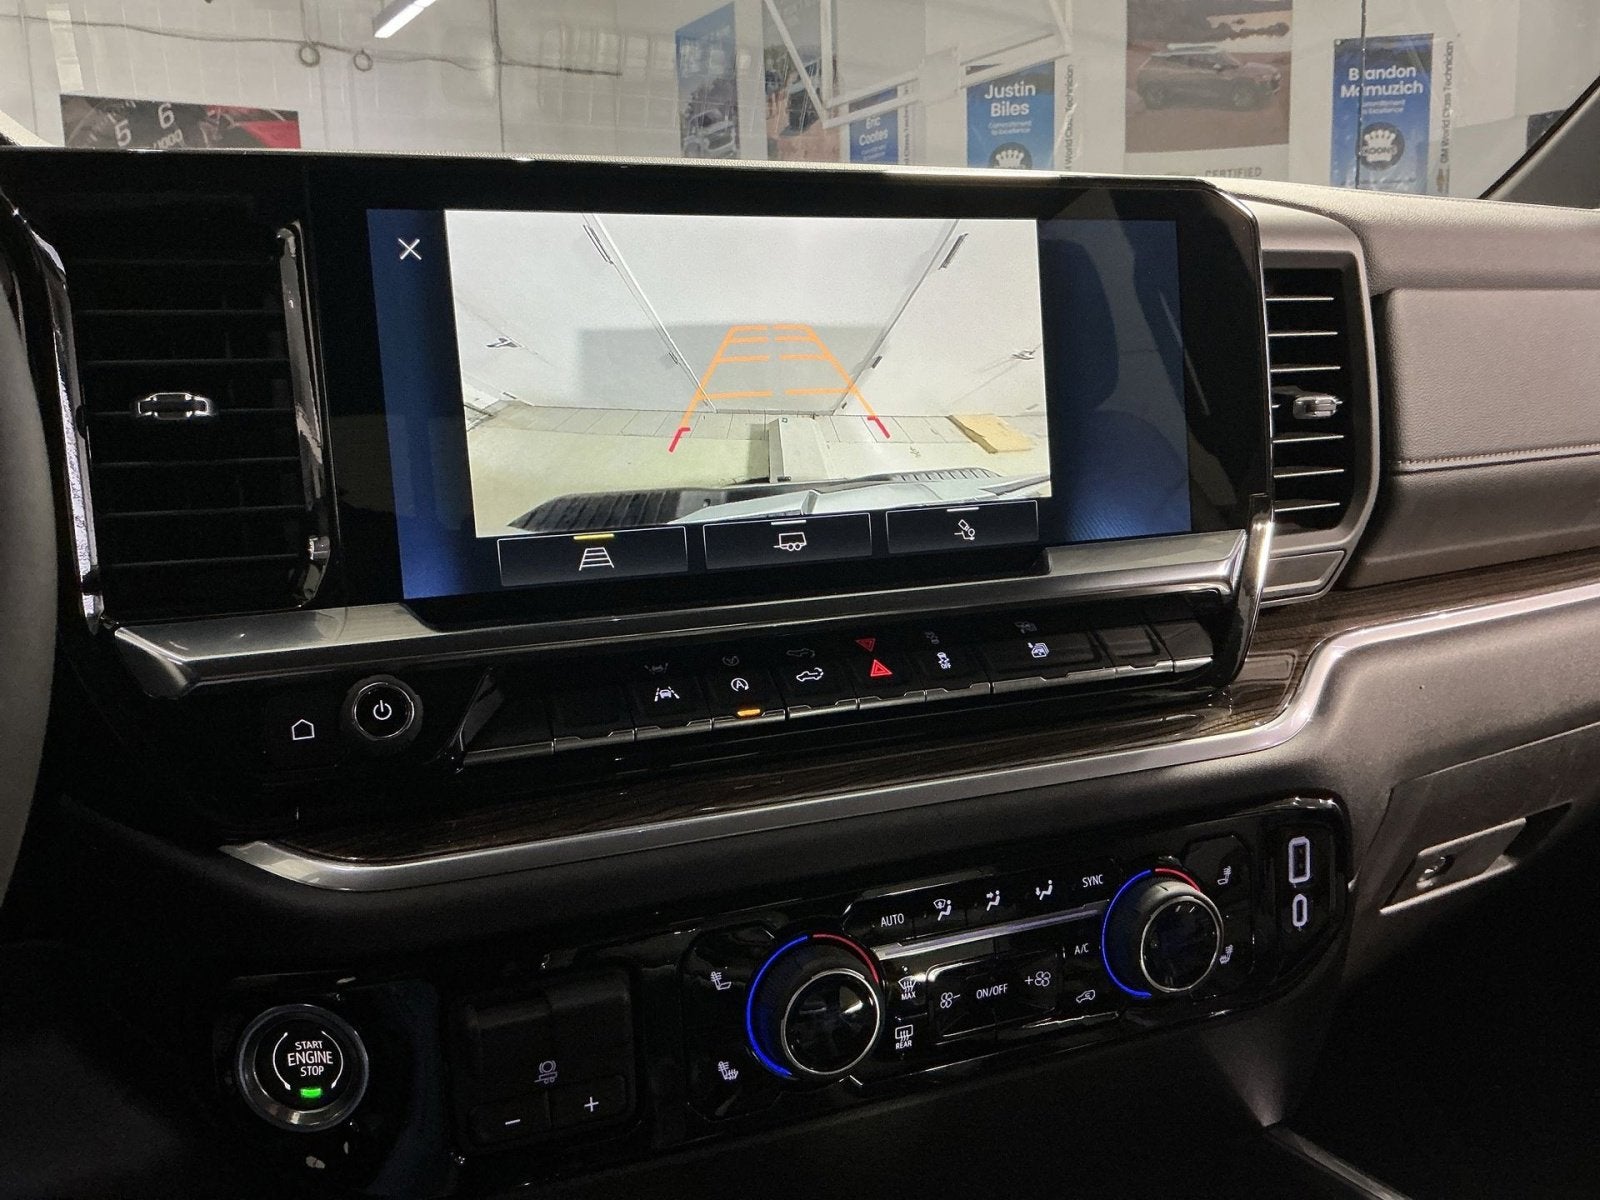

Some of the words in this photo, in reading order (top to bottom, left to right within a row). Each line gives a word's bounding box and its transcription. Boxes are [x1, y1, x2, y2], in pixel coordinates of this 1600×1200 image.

[1348, 65, 1417, 81] Bandon
[1443, 41, 1454, 92] Technician
[984, 80, 1036, 99] Justin
[990, 100, 1030, 117] Biles
[1442, 93, 1452, 118] Class
[158, 102, 175, 129] 6
[114, 119, 132, 147] 5
[1065, 113, 1073, 137] Cla
[1440, 119, 1450, 147] World
[1064, 139, 1073, 165] World
[1082, 873, 1104, 888] SYNC
[880, 912, 905, 928] AUTO
[1074, 942, 1090, 956] A/C
[901, 990, 916, 1001] MAX
[976, 983, 1009, 1000] ON/OFF
[294, 1040, 323, 1051] START
[895, 1039, 912, 1051] REAR
[287, 1050, 334, 1067] ENGINE
[300, 1065, 325, 1077] STOP
